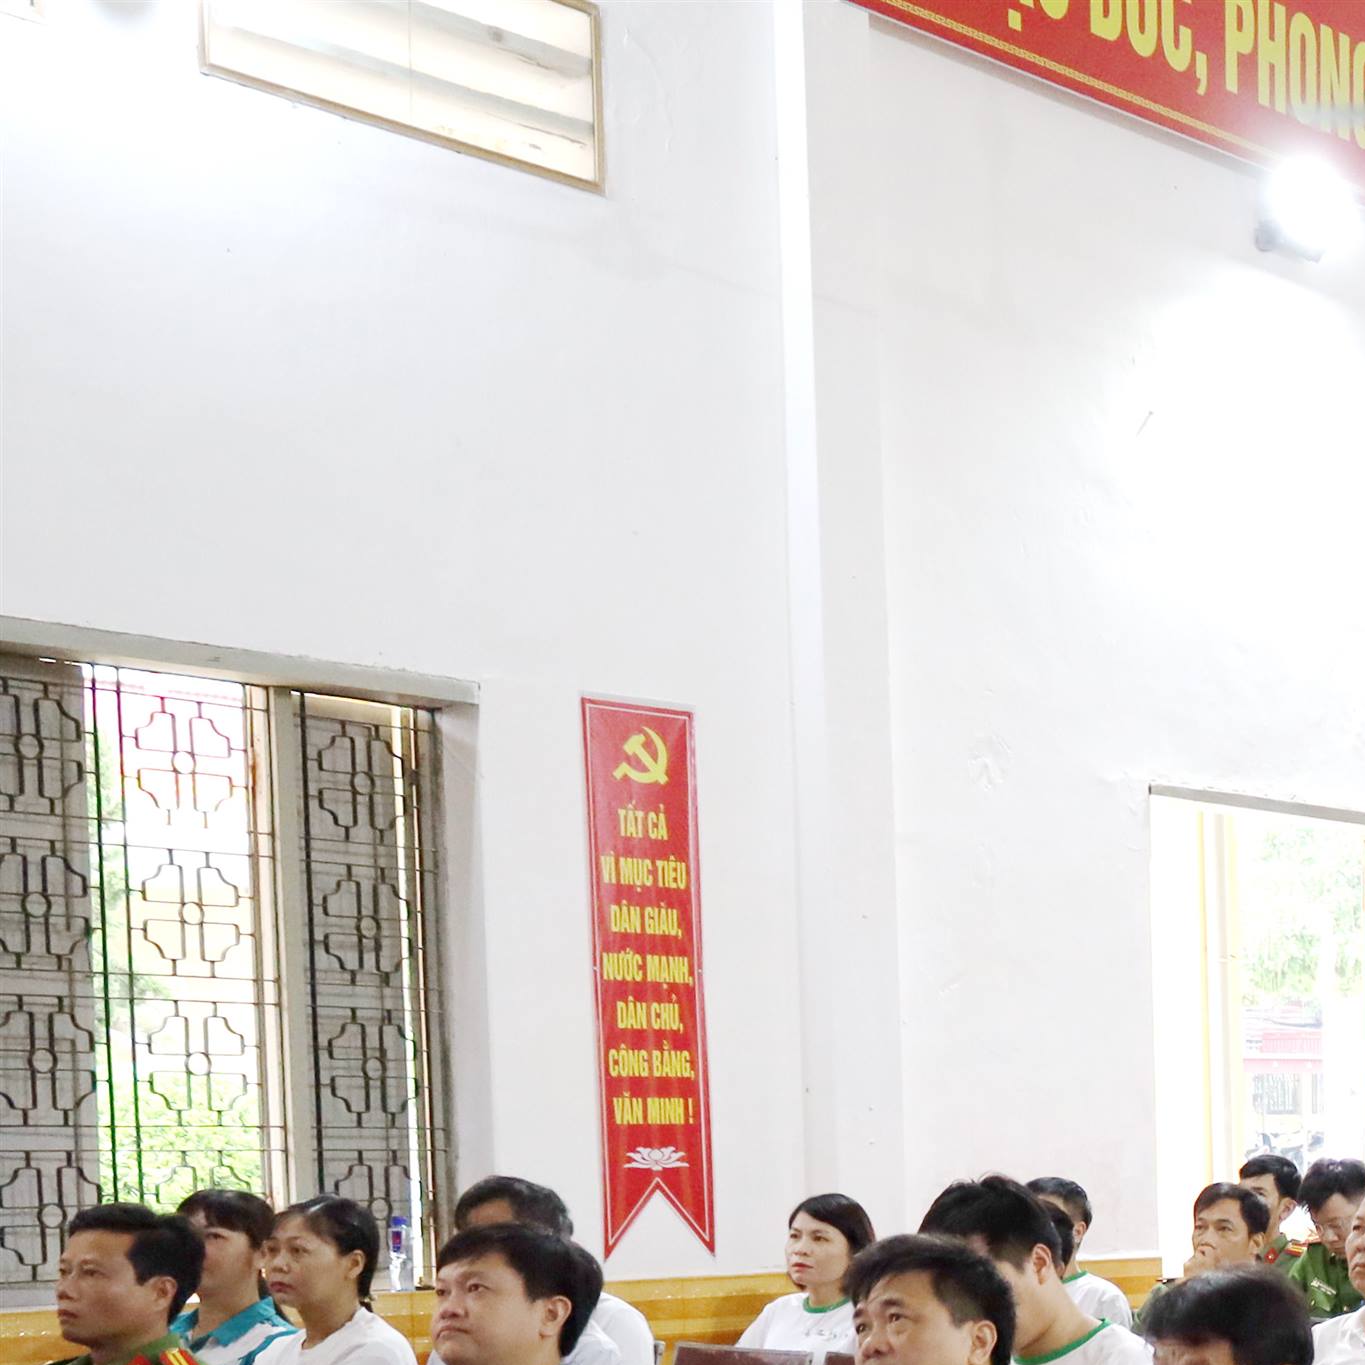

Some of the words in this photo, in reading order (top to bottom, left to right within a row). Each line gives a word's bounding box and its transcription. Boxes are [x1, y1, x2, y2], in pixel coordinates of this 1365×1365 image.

[617, 799, 645, 838] TẤT
[647, 803, 669, 841] CẢ
[600, 851, 617, 884] VÌ
[619, 857, 654, 892] MỤC
[655, 854, 687, 890] TIÊU
[610, 899, 642, 934] DÂN
[643, 902, 683, 940] GIÀU,
[601, 948, 643, 982] NƯỚC
[646, 953, 694, 990] MẠNH,
[616, 995, 648, 1030] DÂN
[650, 993, 684, 1034] CHỦ,
[608, 1042, 649, 1078] CÔNG
[651, 1039, 696, 1081] BẰNG,
[613, 1090, 644, 1125] VĂN
[646, 1096, 685, 1125] MINH
[687, 1097, 695, 1125] !
